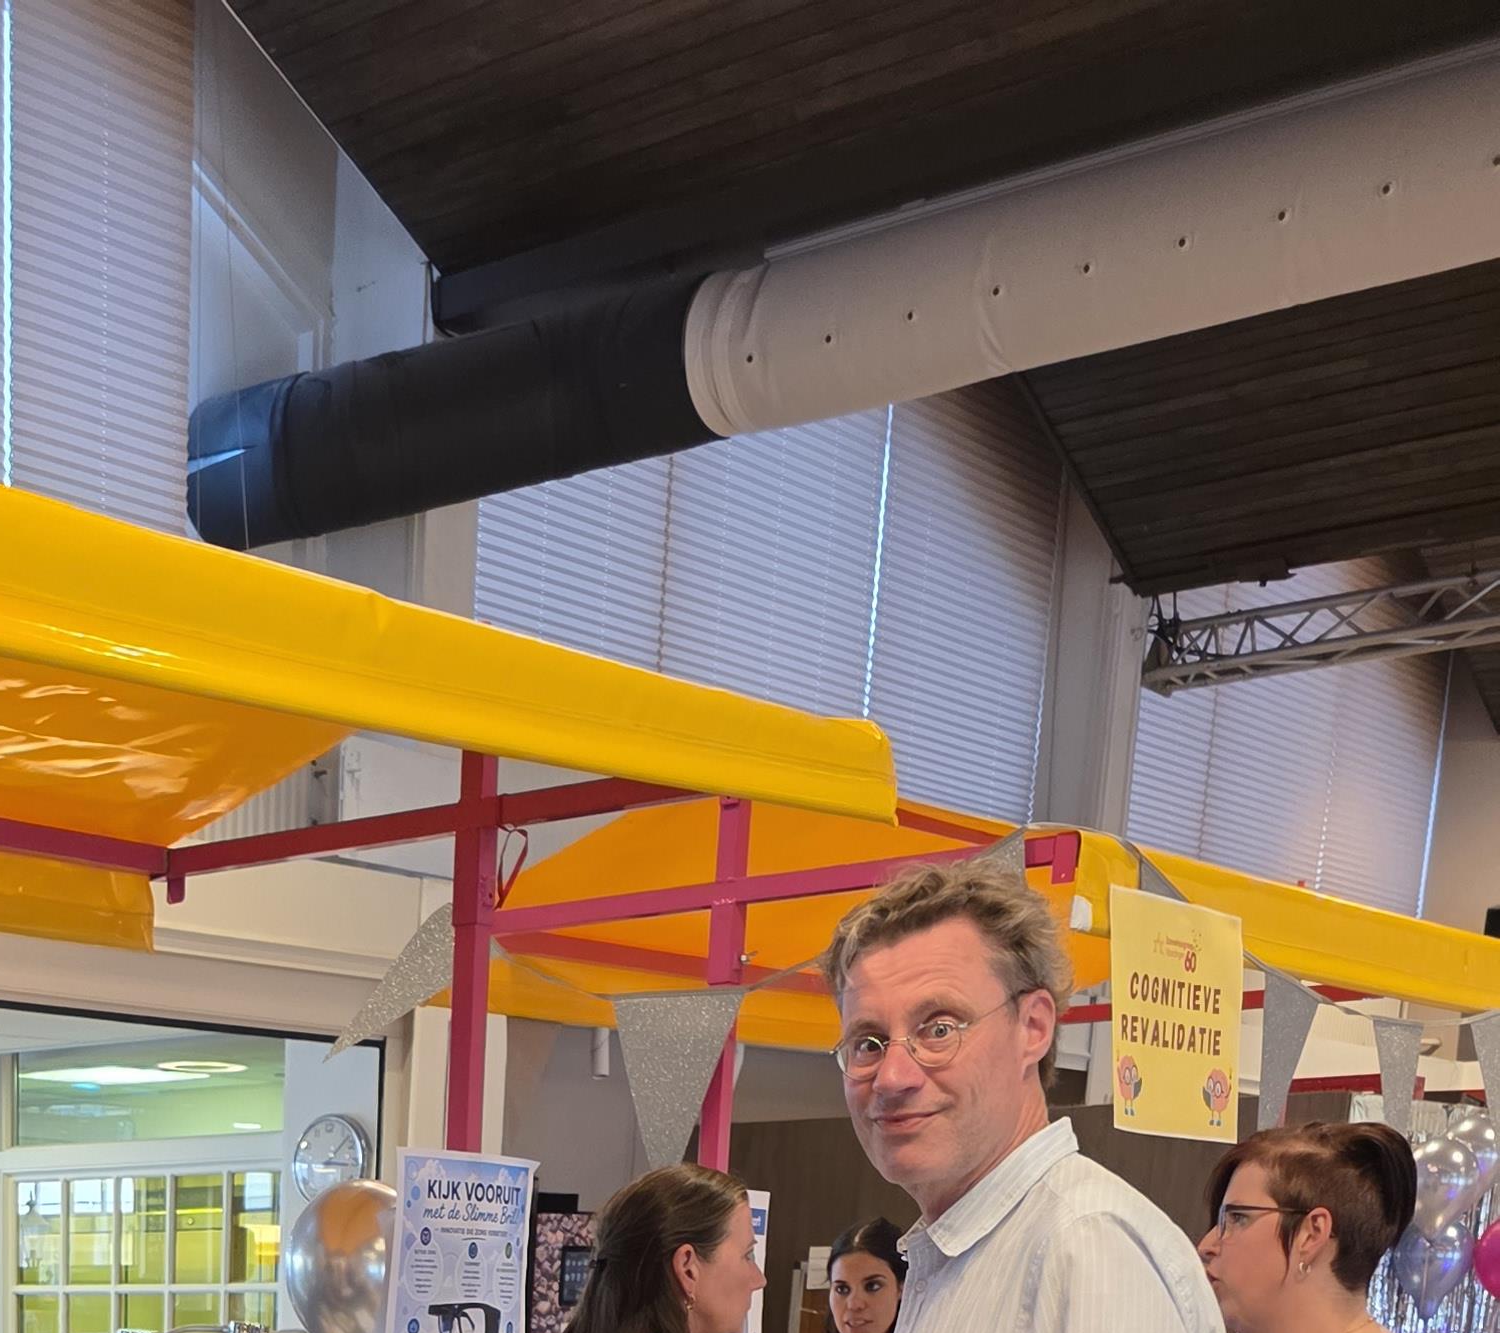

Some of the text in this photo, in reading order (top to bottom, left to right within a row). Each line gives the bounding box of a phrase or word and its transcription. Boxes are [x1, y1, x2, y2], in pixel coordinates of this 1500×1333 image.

[1184, 950, 1197, 973] 60
[1129, 971, 1221, 1014] COGNITIEVE
[1120, 1013, 1222, 1056] REVALIDATIE
[427, 1179, 521, 1206] KIJK VOORUIT
[422, 1202, 446, 1219] met
[447, 1202, 461, 1220] de
